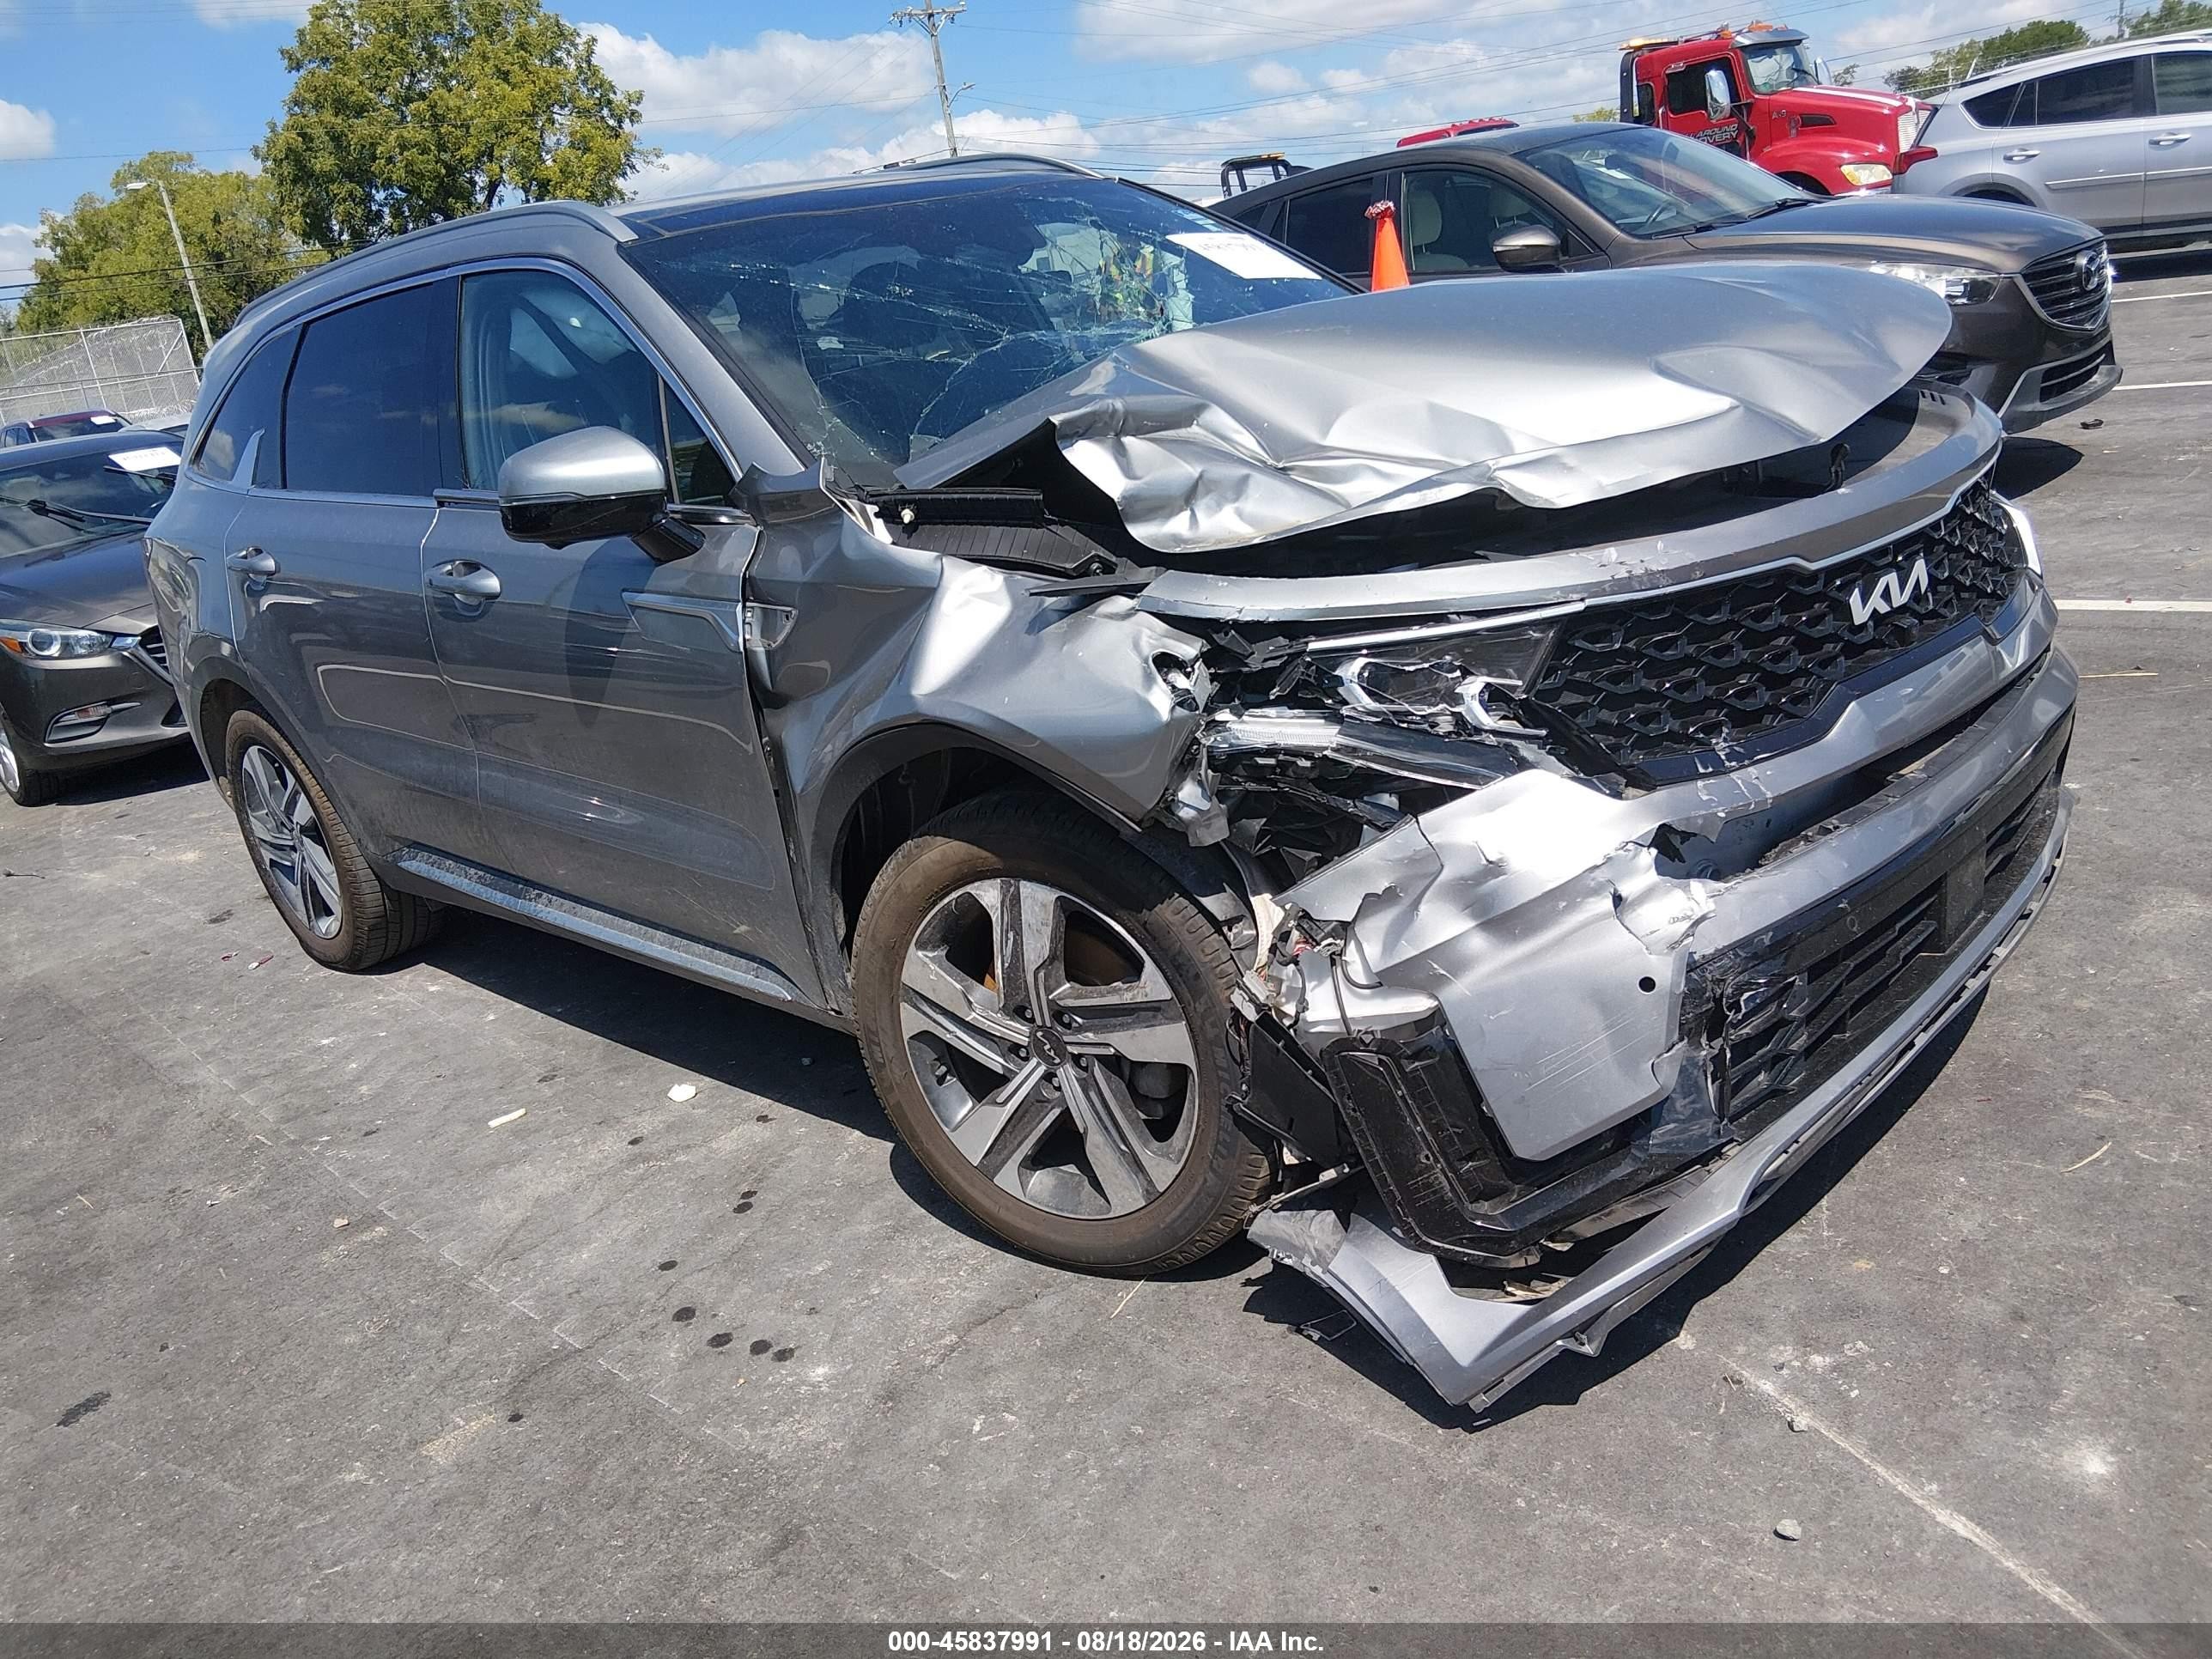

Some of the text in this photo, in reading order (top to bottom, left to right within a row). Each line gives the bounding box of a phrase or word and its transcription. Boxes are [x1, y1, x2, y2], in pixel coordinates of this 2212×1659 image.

[1696, 124, 1738, 137] AROUND
[1697, 131, 1738, 144] OVERY
[1850, 558, 1929, 625] KIA
